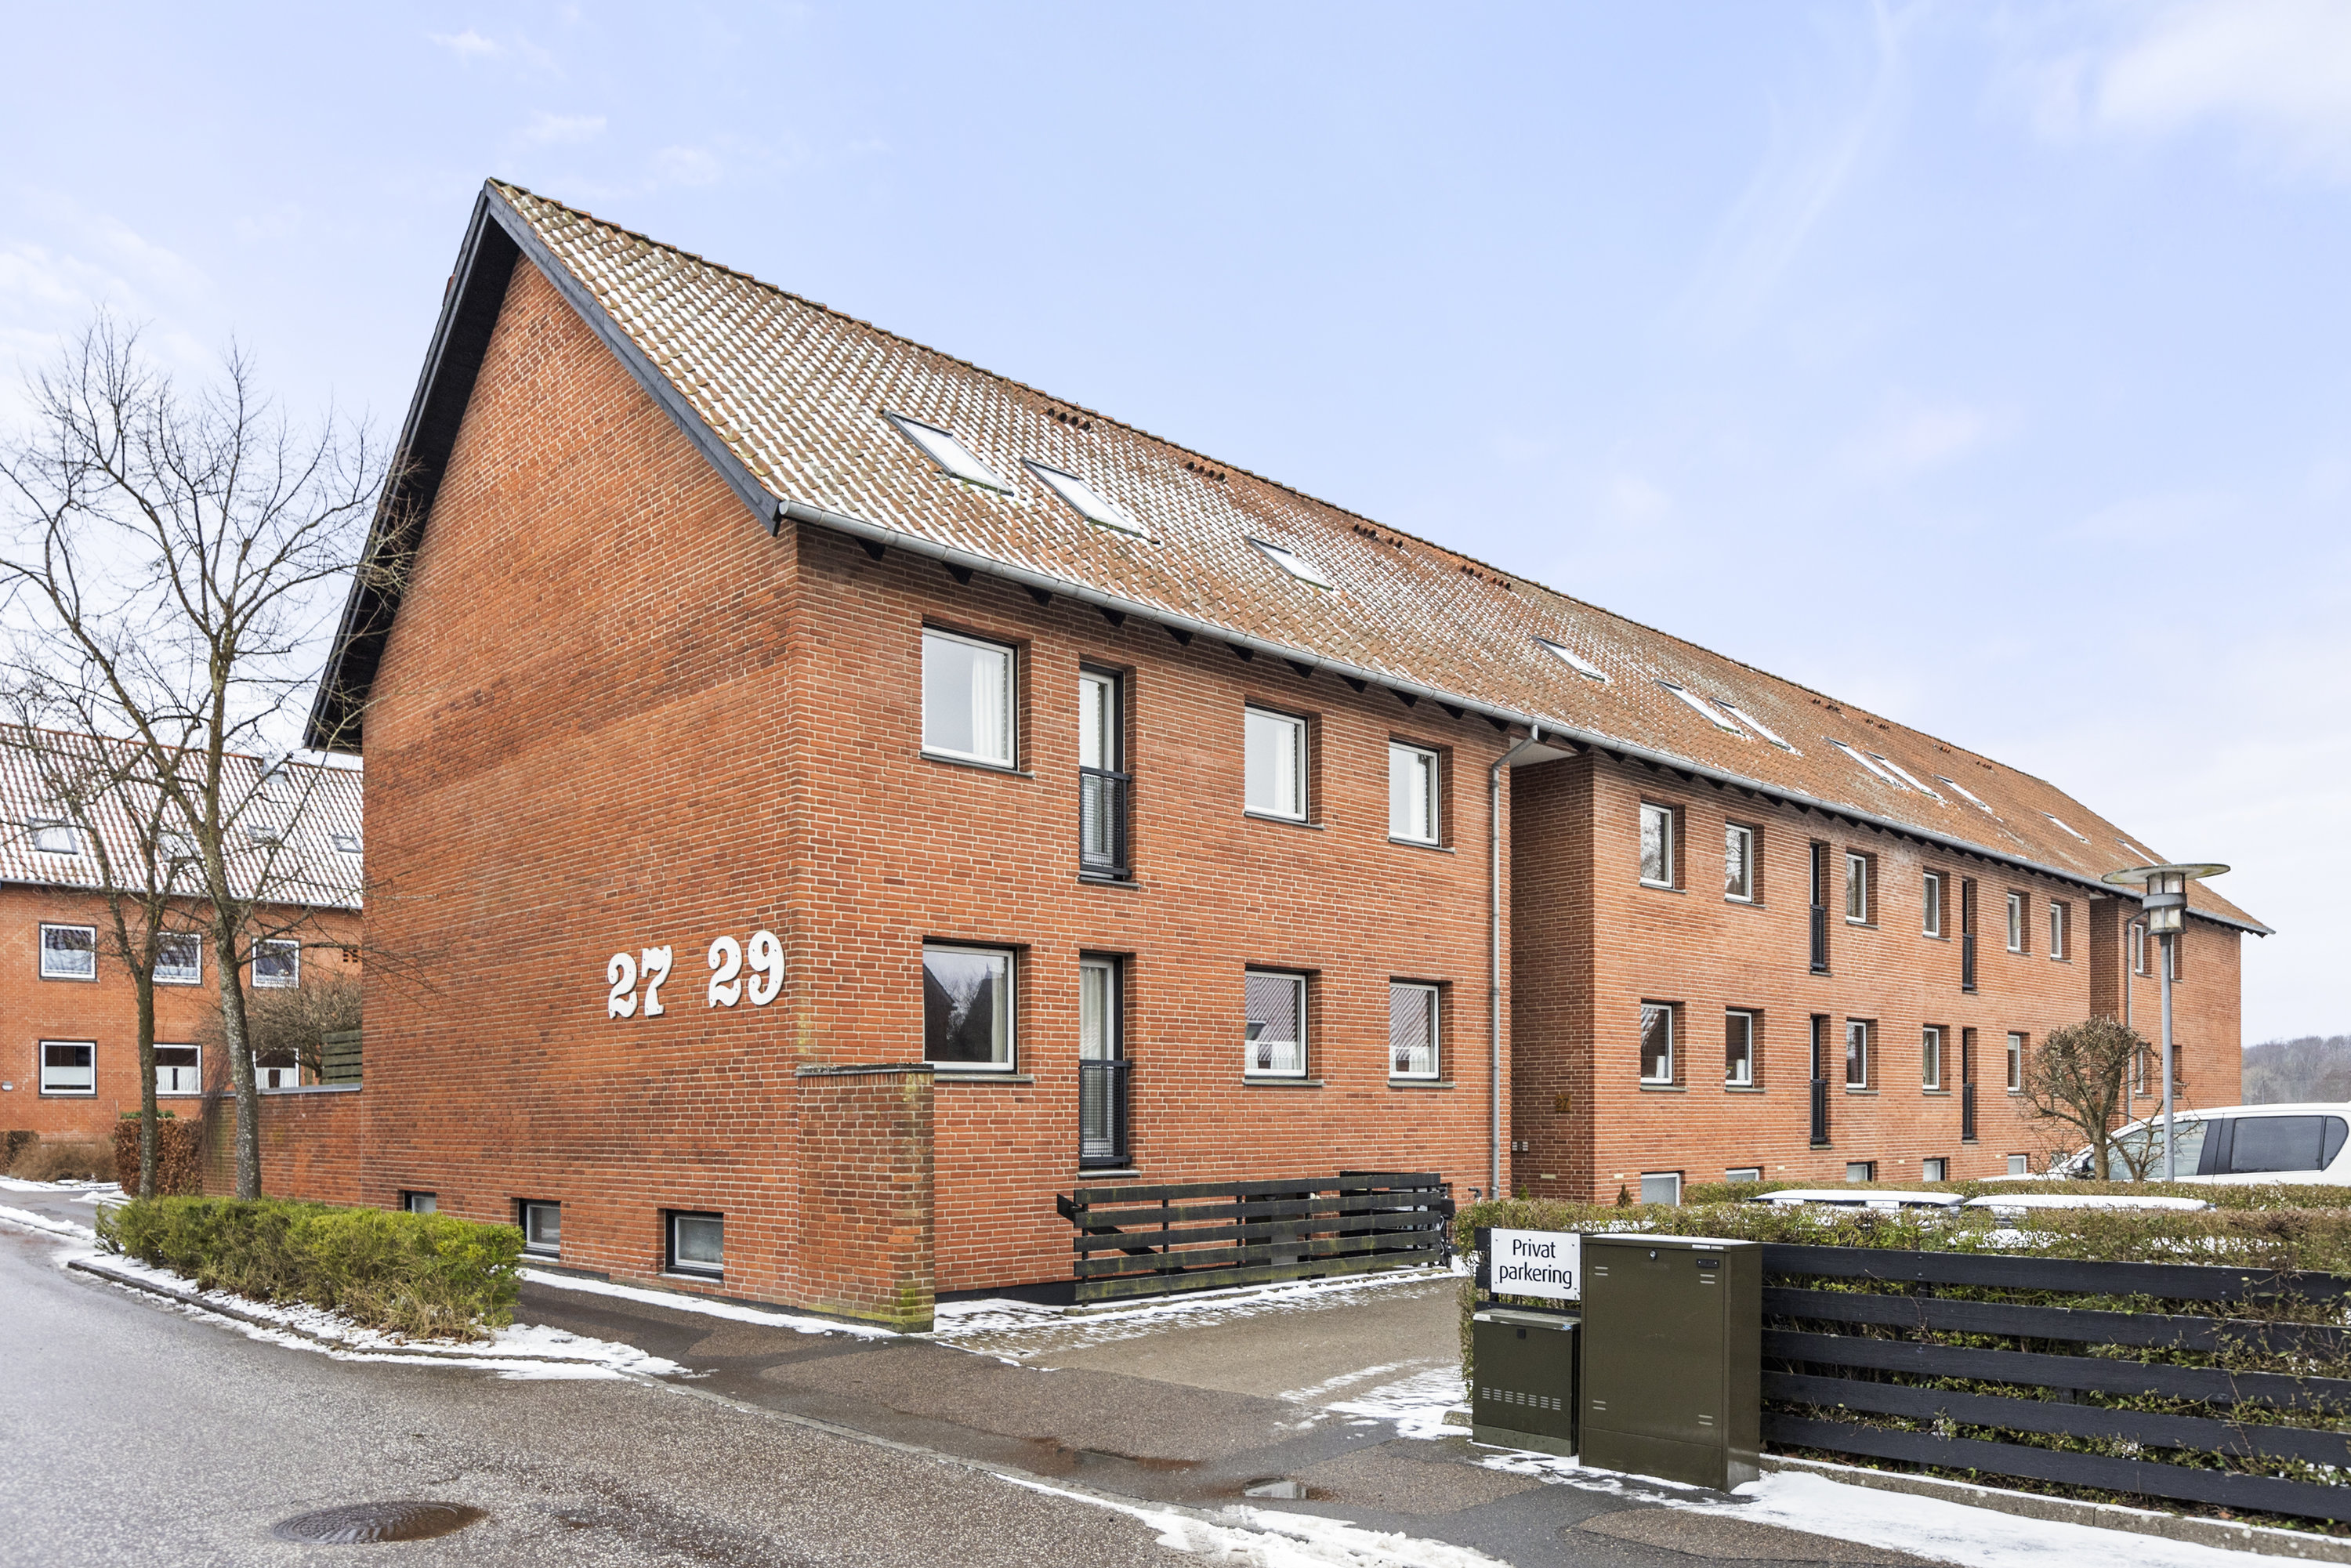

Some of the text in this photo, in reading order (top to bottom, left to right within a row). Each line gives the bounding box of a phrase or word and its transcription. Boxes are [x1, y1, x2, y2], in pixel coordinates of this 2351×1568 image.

[607, 930, 785, 1019] 27 29
[1556, 1098, 1570, 1109] 27
[1512, 1238, 1556, 1258] Privat
[1499, 1262, 1572, 1290] parkering
